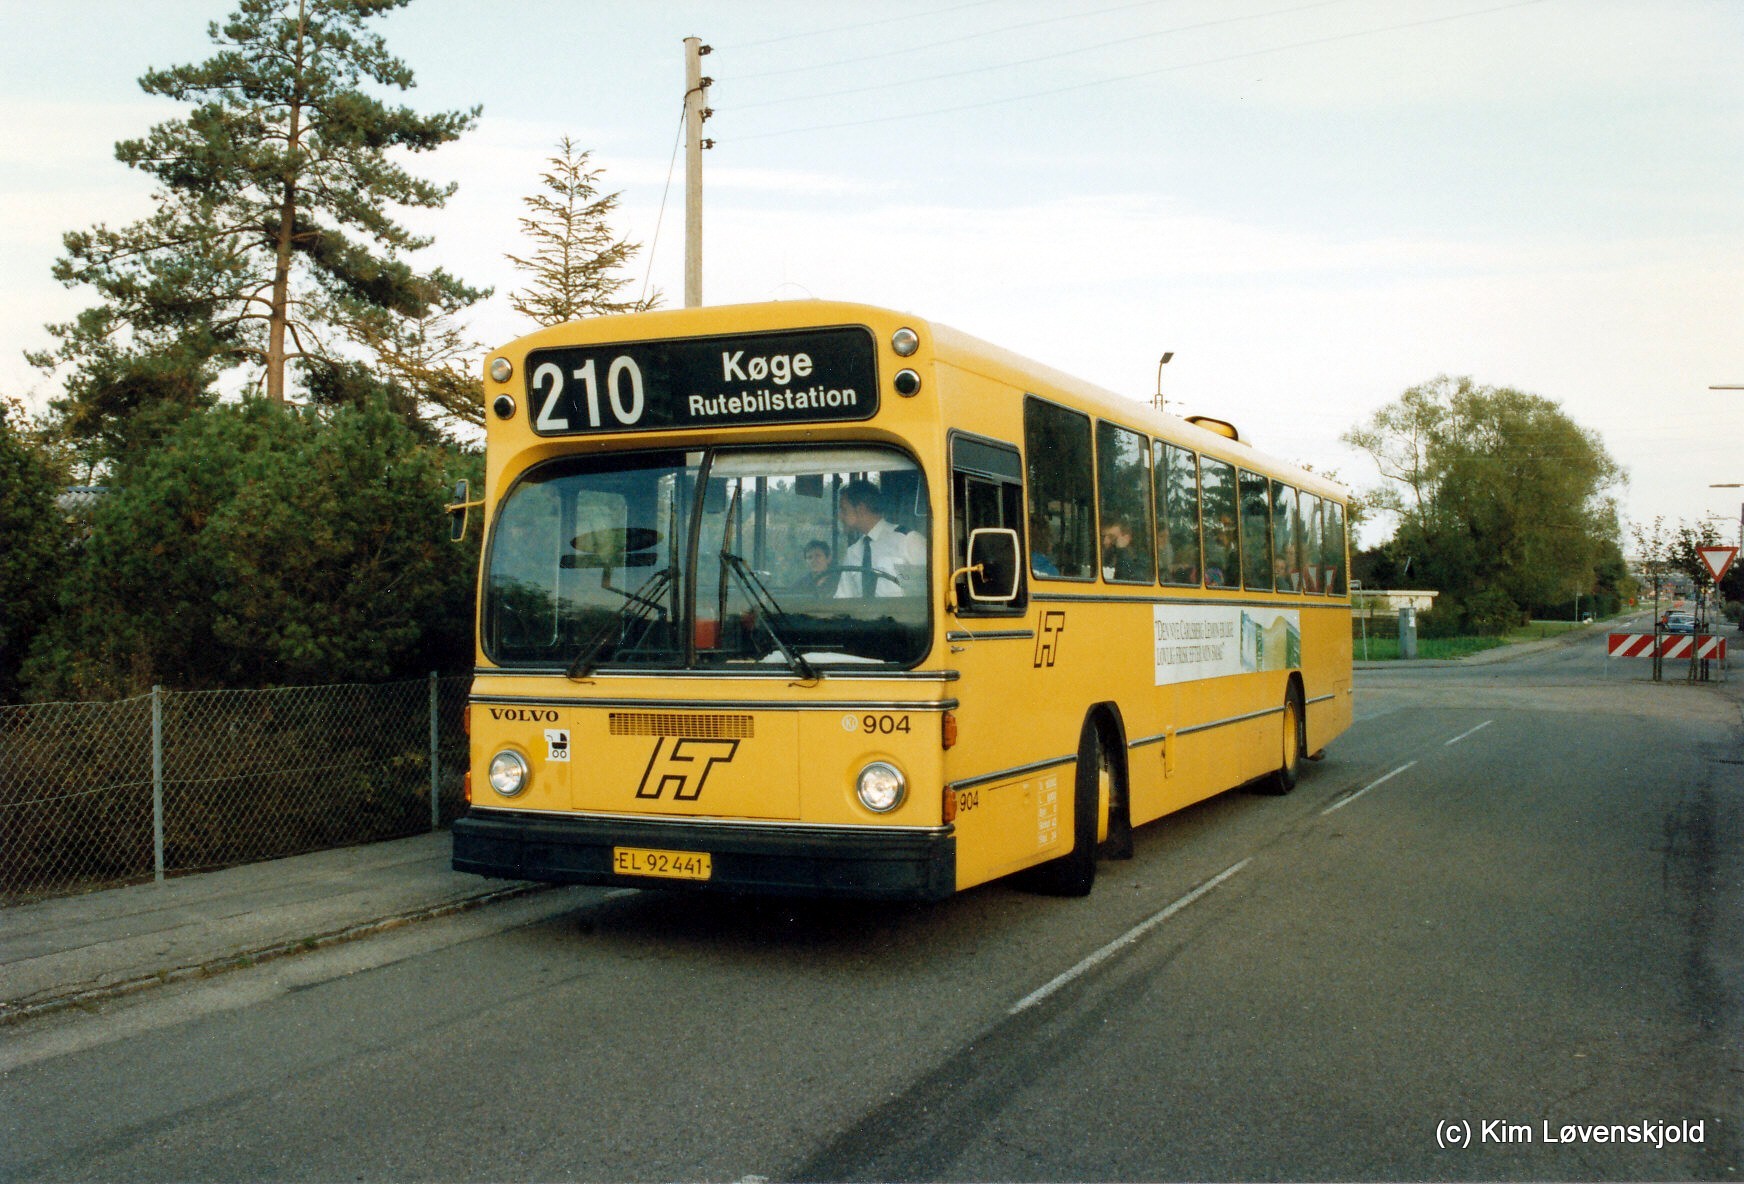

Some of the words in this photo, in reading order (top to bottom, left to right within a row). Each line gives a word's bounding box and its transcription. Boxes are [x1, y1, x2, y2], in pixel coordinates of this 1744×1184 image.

[722, 349, 813, 386] Køge
[532, 354, 645, 431] 210
[688, 386, 857, 417] Rutebilstation
[489, 708, 559, 723] VOLVO
[862, 714, 911, 735] 904
[960, 790, 979, 812] 904
[619, 852, 641, 870] EL
